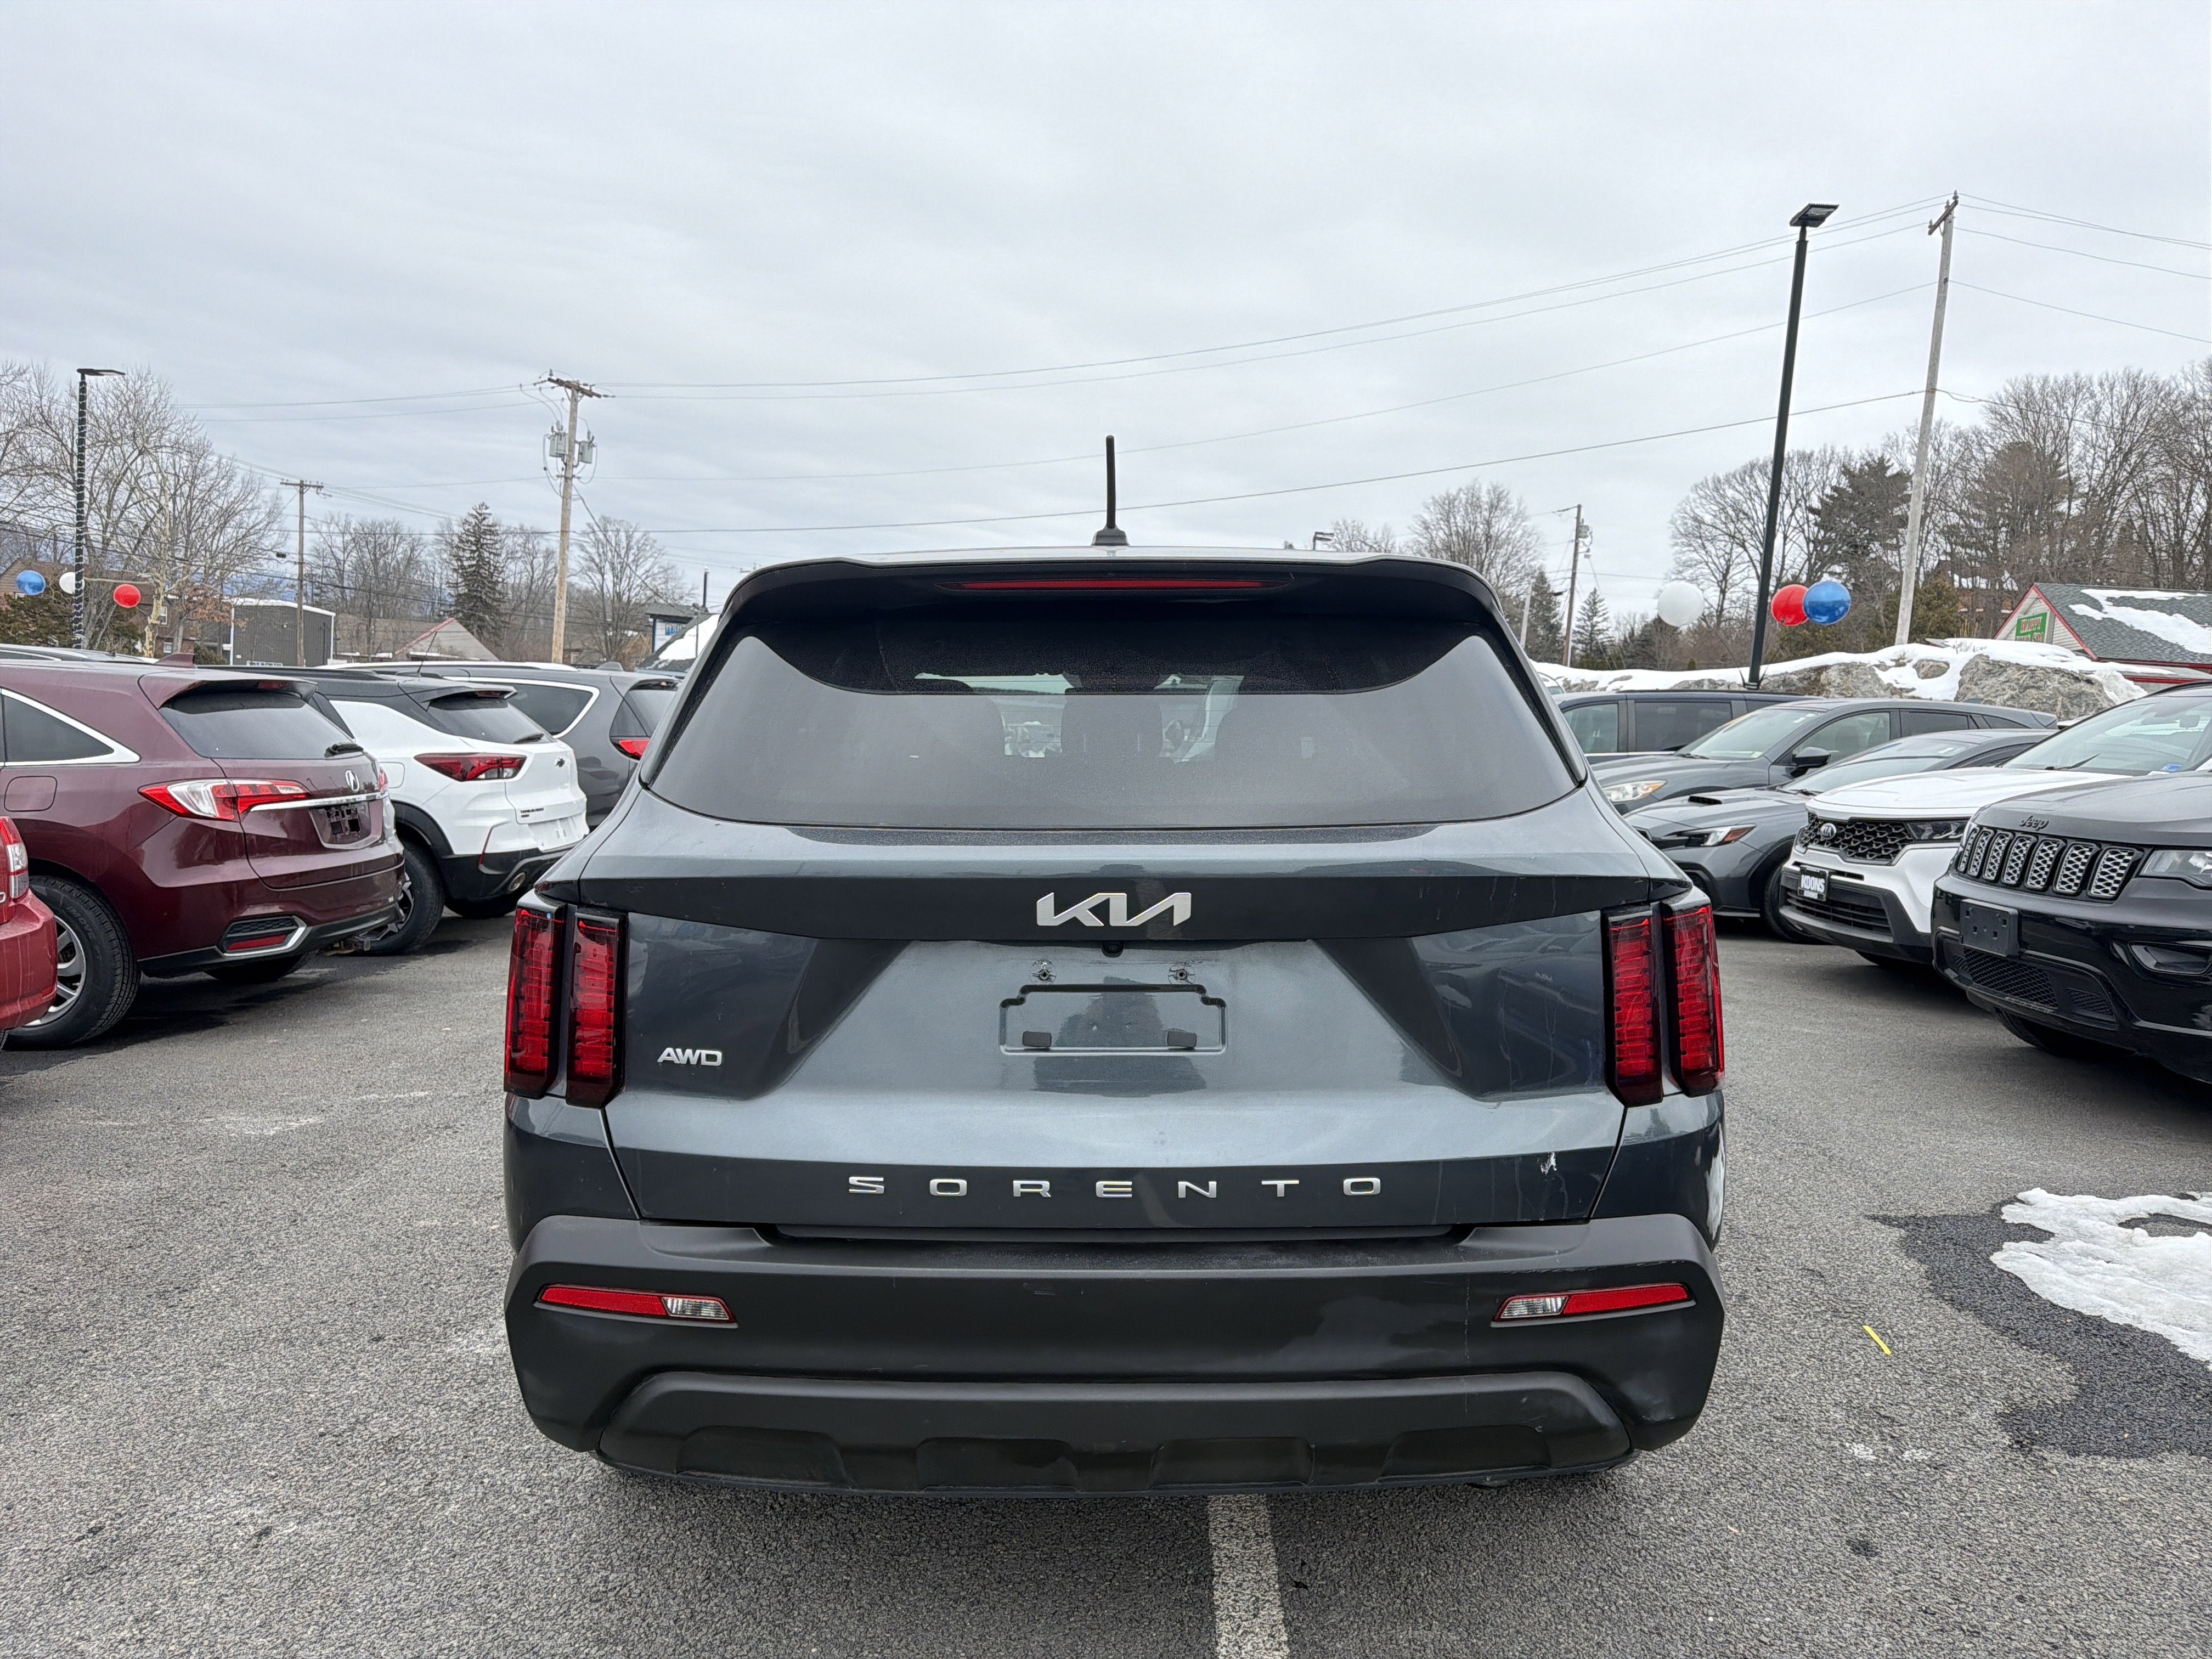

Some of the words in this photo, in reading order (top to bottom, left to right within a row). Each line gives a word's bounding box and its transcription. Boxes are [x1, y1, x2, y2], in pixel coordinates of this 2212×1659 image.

[1821, 826, 1832, 837] KIA
[2019, 815, 2049, 831] Jeep
[1801, 874, 1825, 893] KOONS
[1036, 892, 1192, 927] KIA
[657, 1047, 723, 1067] AWD
[848, 1176, 1382, 1198] SORENTO
